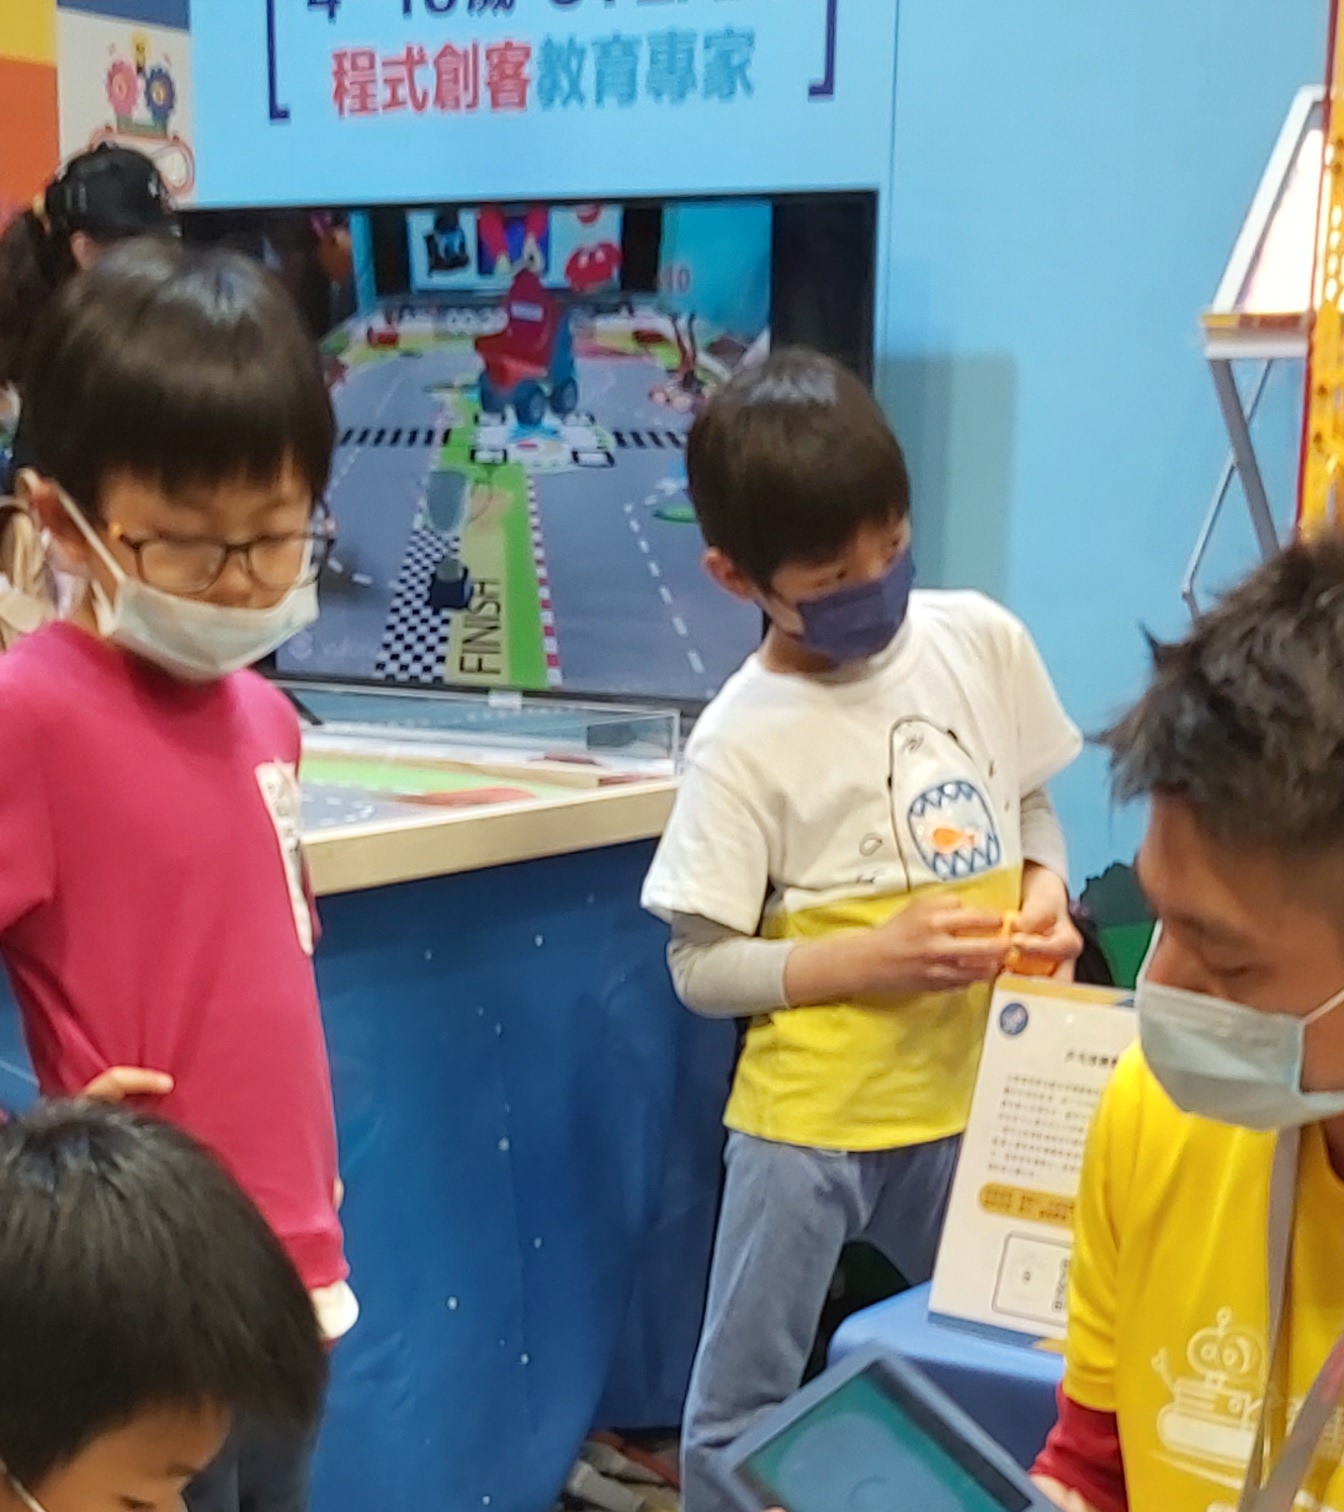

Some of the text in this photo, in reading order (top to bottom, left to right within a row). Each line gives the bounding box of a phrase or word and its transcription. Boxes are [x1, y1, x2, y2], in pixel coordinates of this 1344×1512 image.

[332, 27, 755, 118] 程式創客教育專家
[460, 578, 501, 674] FINISH
